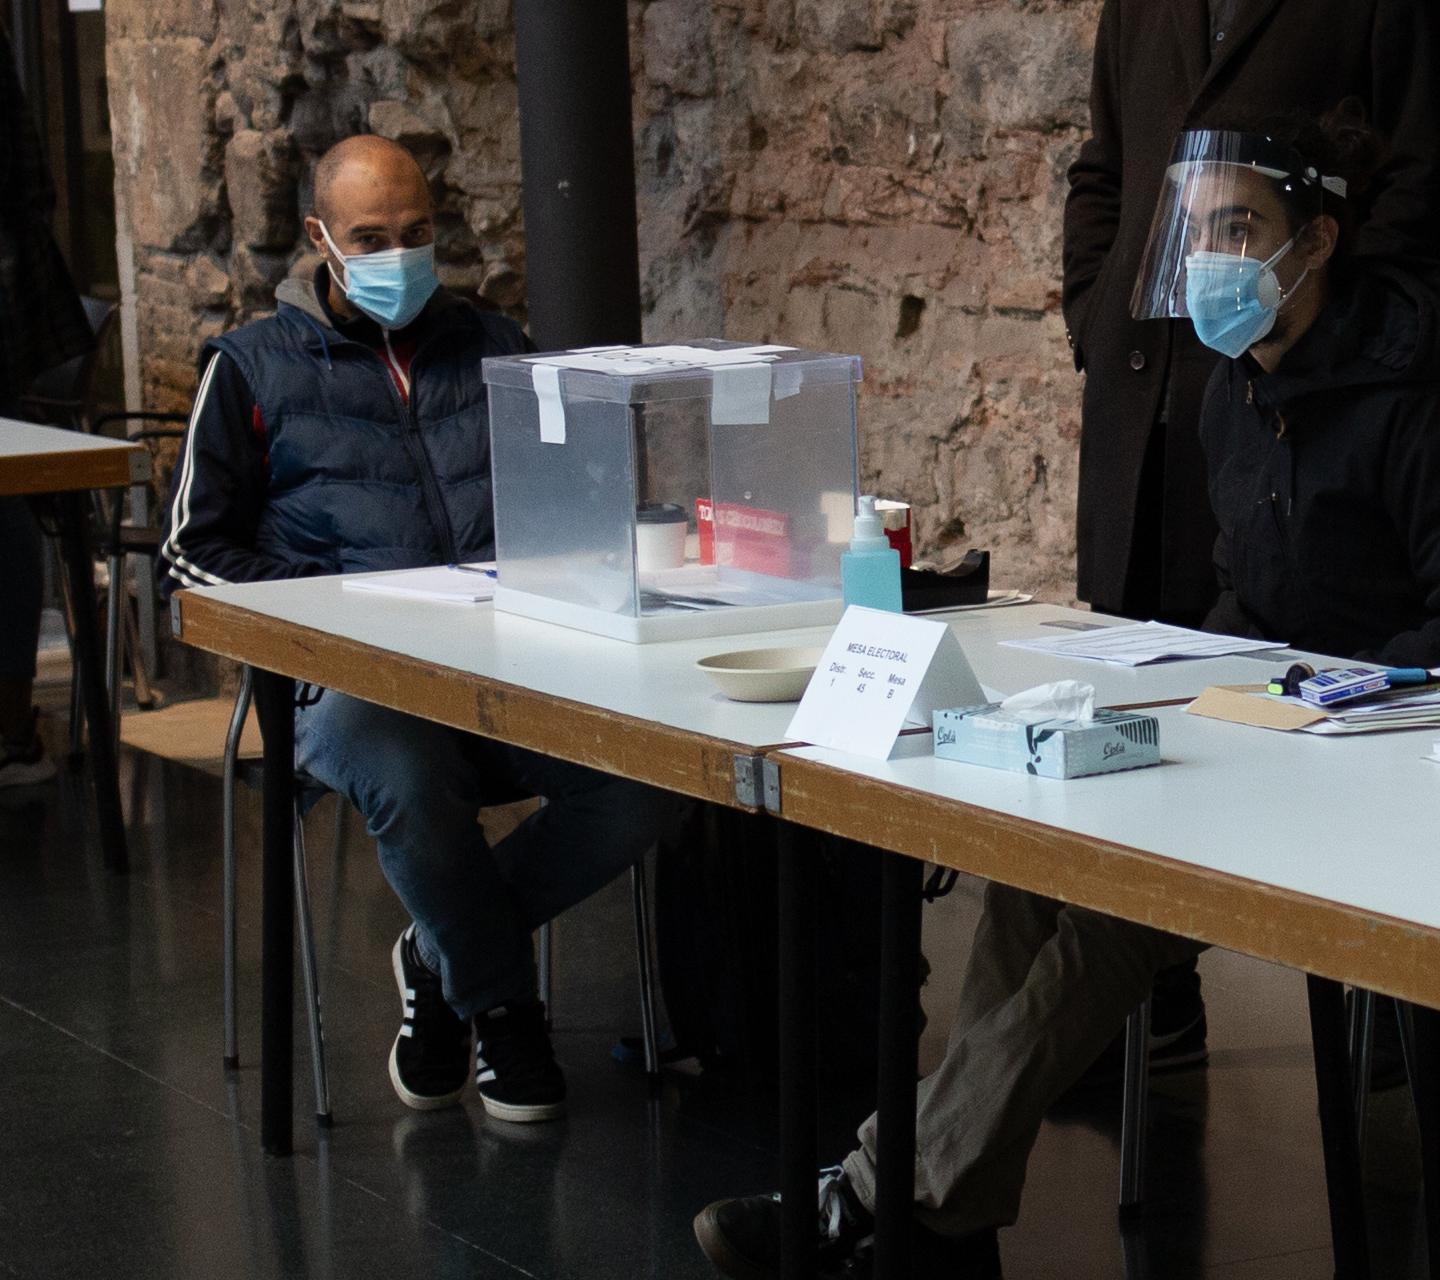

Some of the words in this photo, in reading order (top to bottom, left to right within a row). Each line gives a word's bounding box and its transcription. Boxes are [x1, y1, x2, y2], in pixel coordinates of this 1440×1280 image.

[847, 642, 867, 654] MESA
[867, 646, 908, 663] ELECTORAL
[888, 673, 907, 686] Mesa
